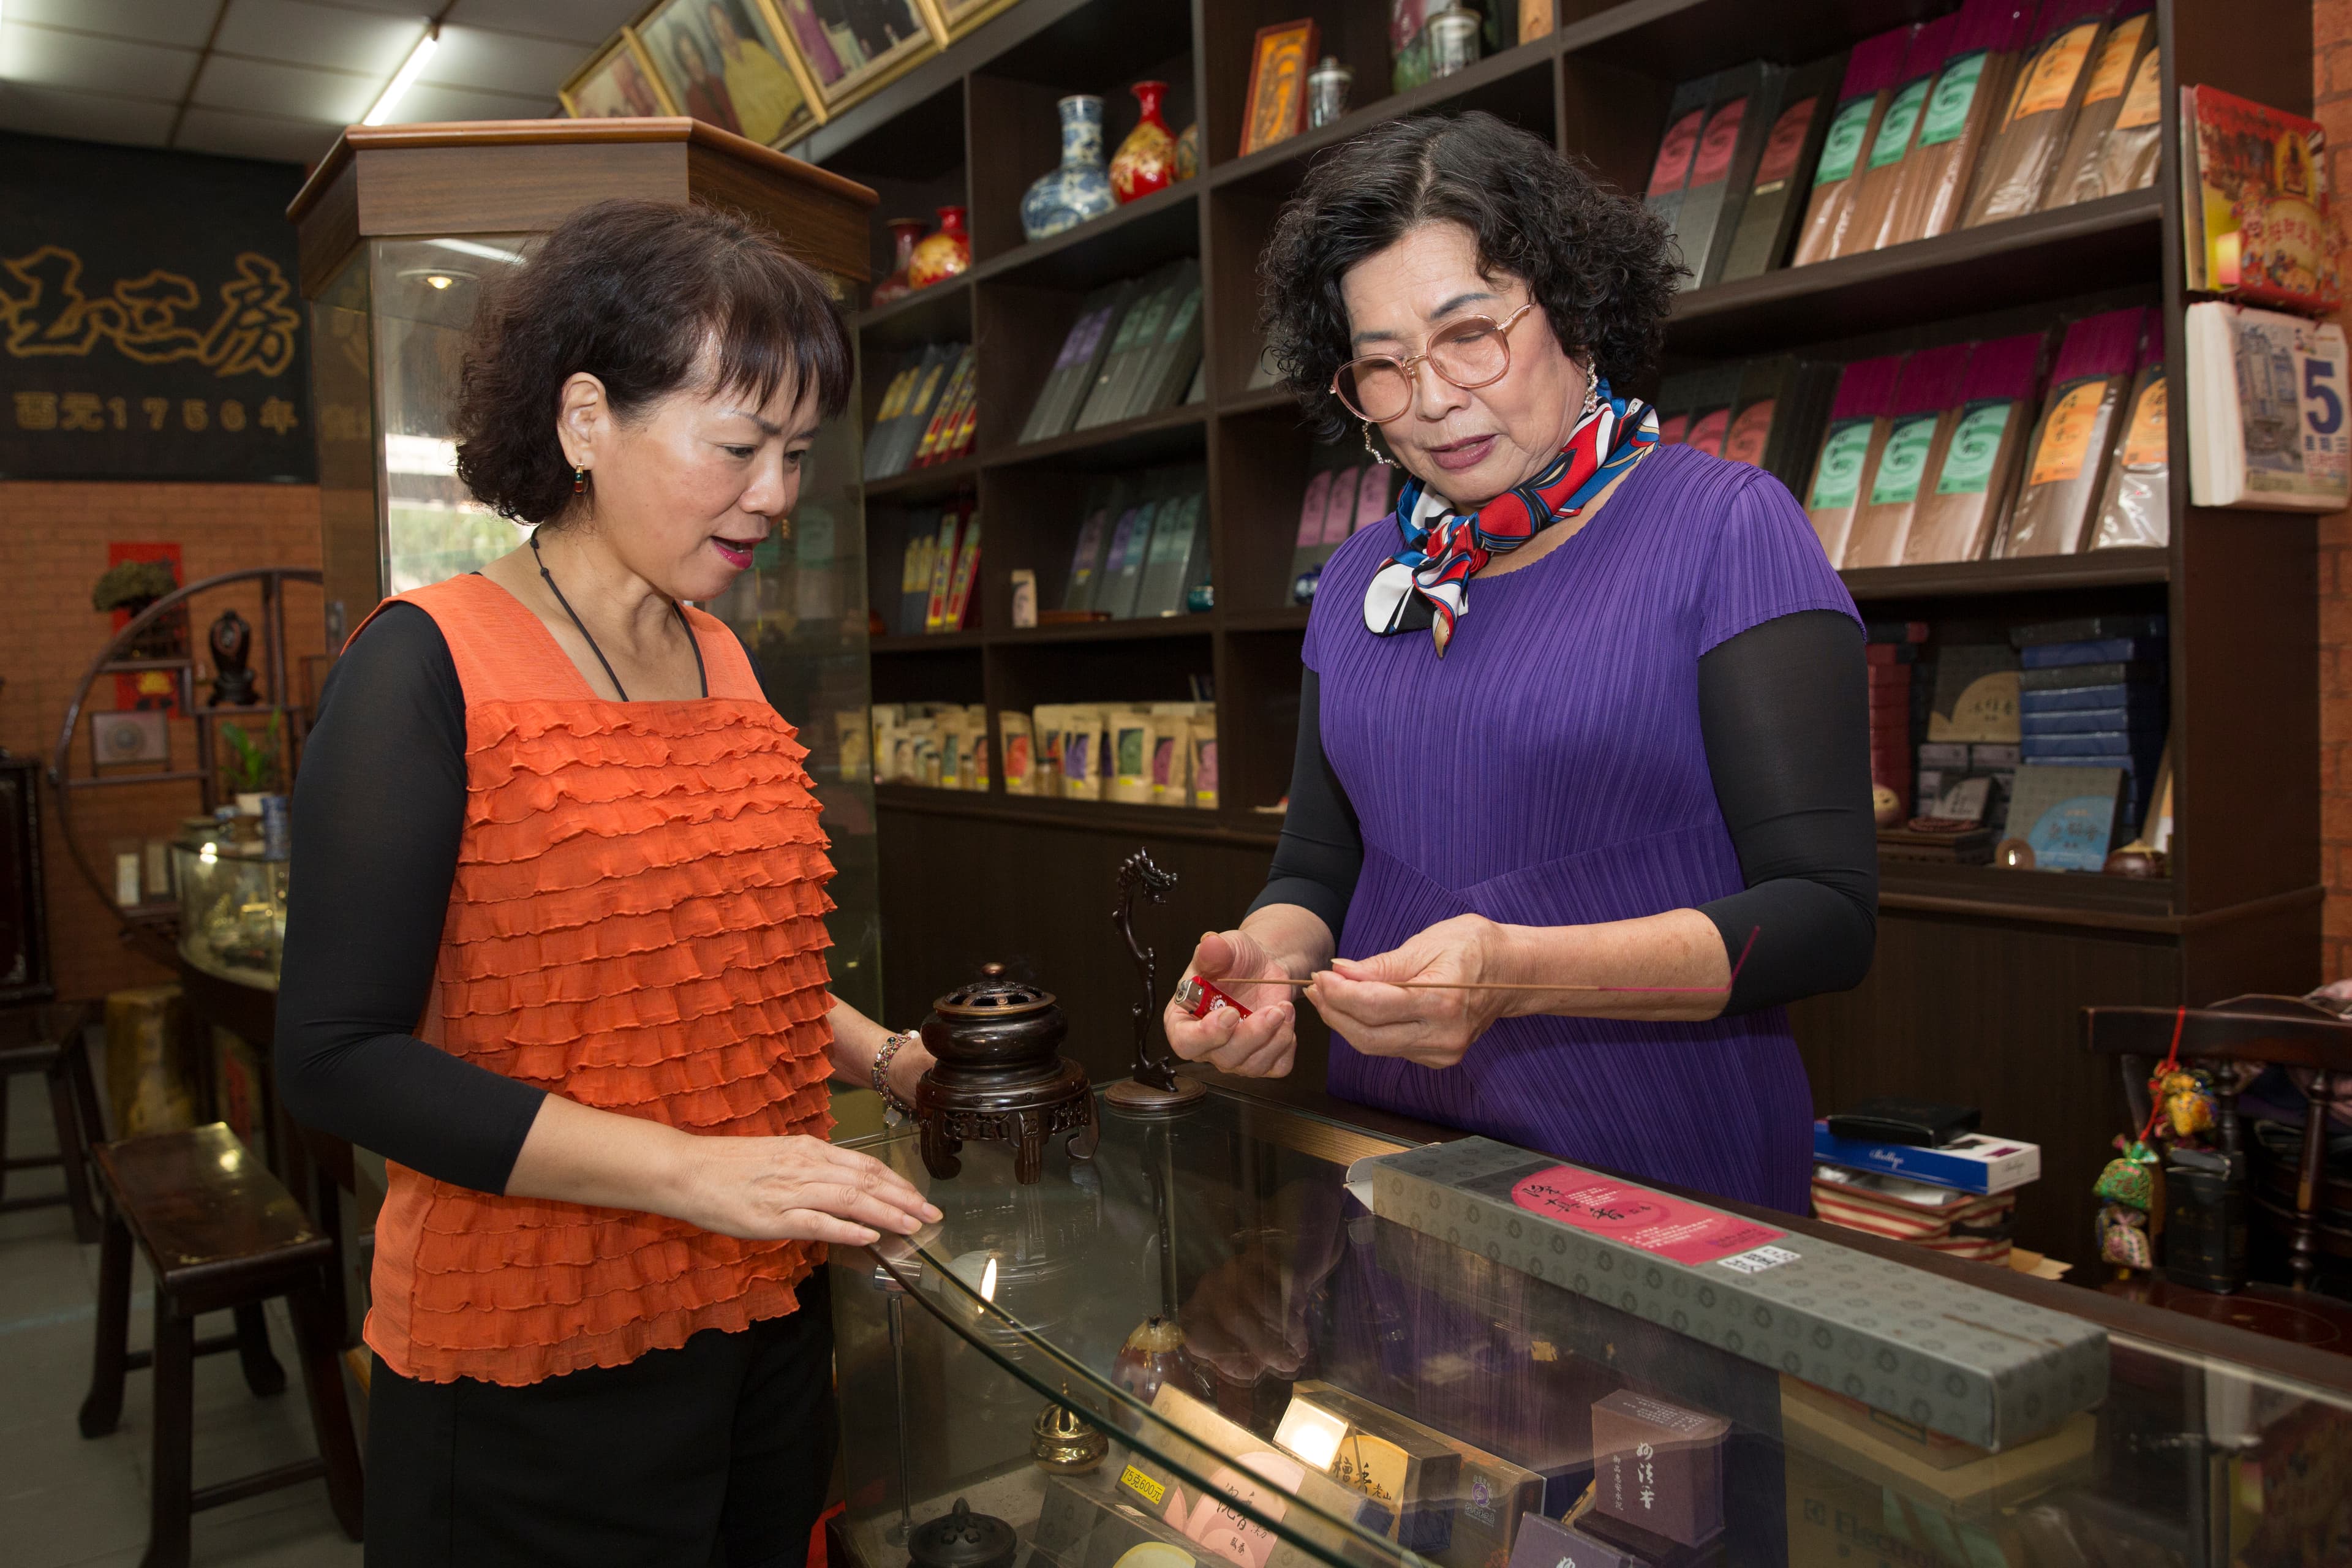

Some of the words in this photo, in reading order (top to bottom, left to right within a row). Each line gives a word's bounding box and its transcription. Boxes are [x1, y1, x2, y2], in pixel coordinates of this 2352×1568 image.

[2304, 357, 2343, 434] 5
[1123, 1469, 1163, 1502] 75克600元
[1373, 1483, 1392, 1501] 老山
[1231, 1537, 1245, 1556] 臥香
